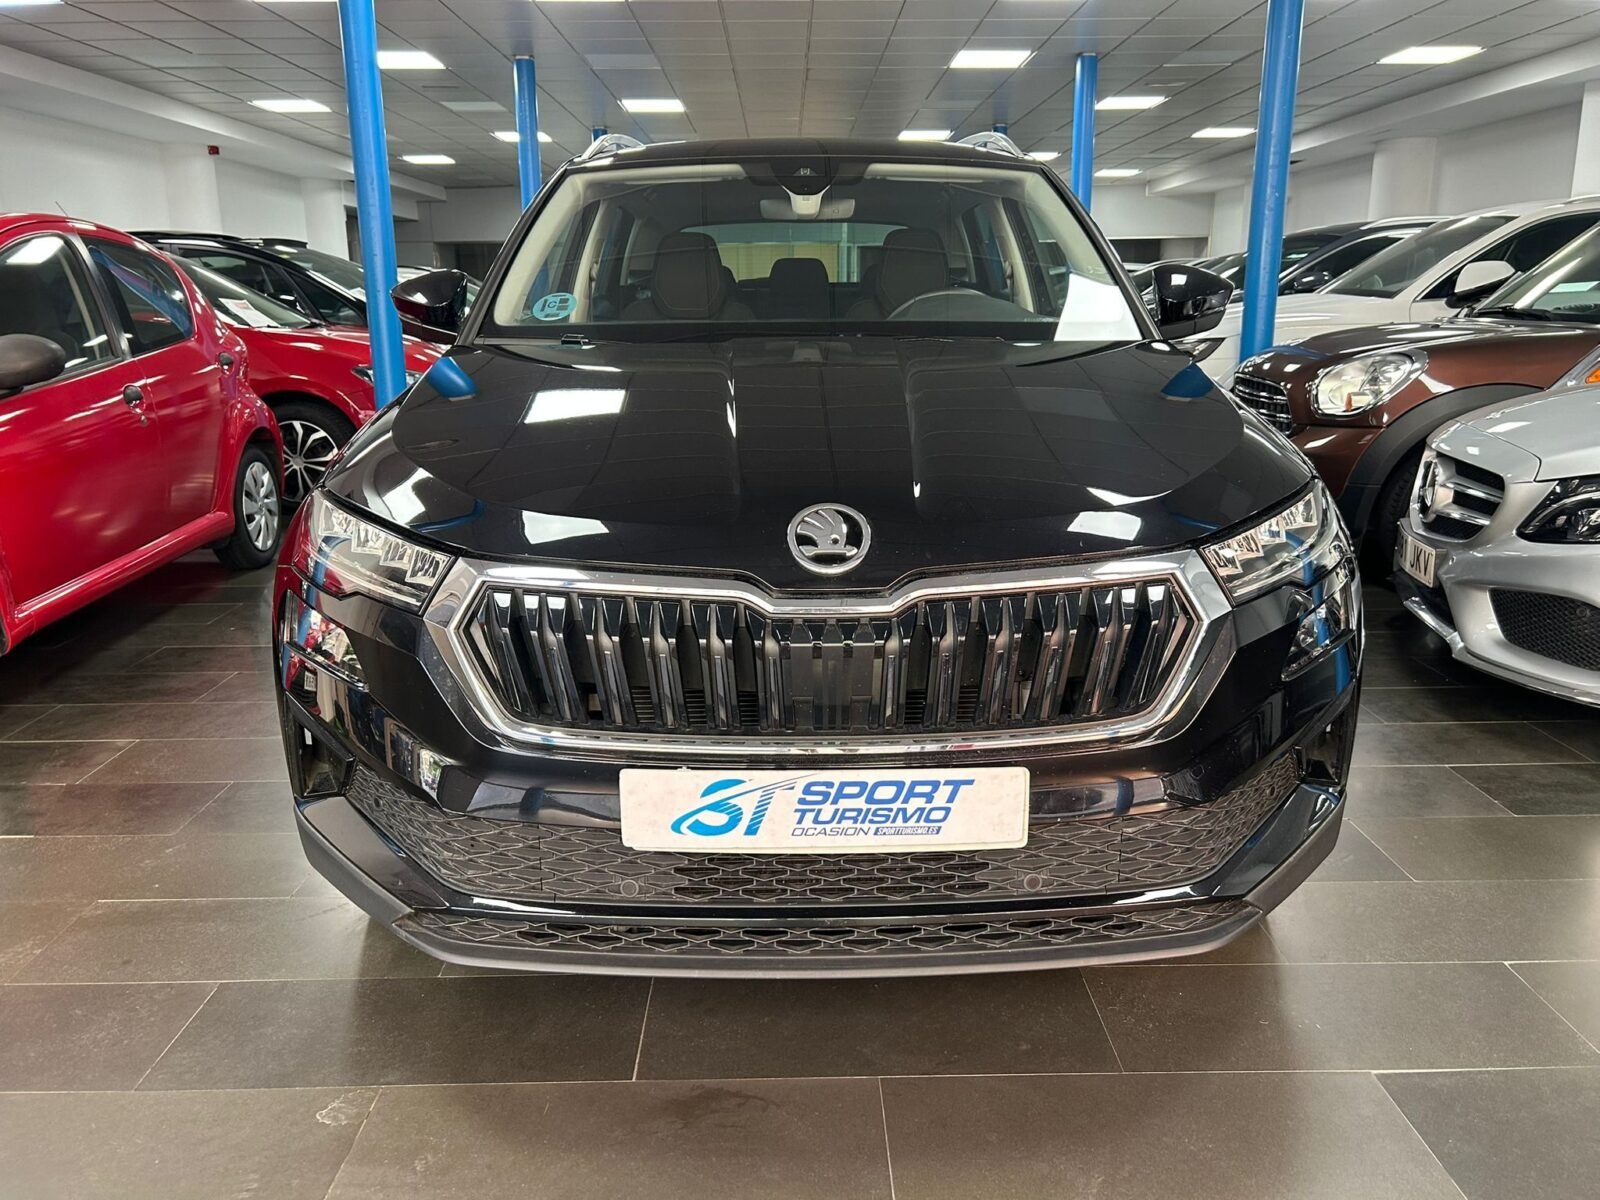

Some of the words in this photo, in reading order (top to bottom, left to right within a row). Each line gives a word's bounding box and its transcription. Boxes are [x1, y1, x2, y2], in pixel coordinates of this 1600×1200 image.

[1409, 544, 1431, 577] JKV
[796, 778, 976, 807] SPORT
[793, 806, 952, 826] TURISMO
[790, 826, 871, 837] OCASION
[875, 824, 941, 836] SPORTTURISMO.ES
